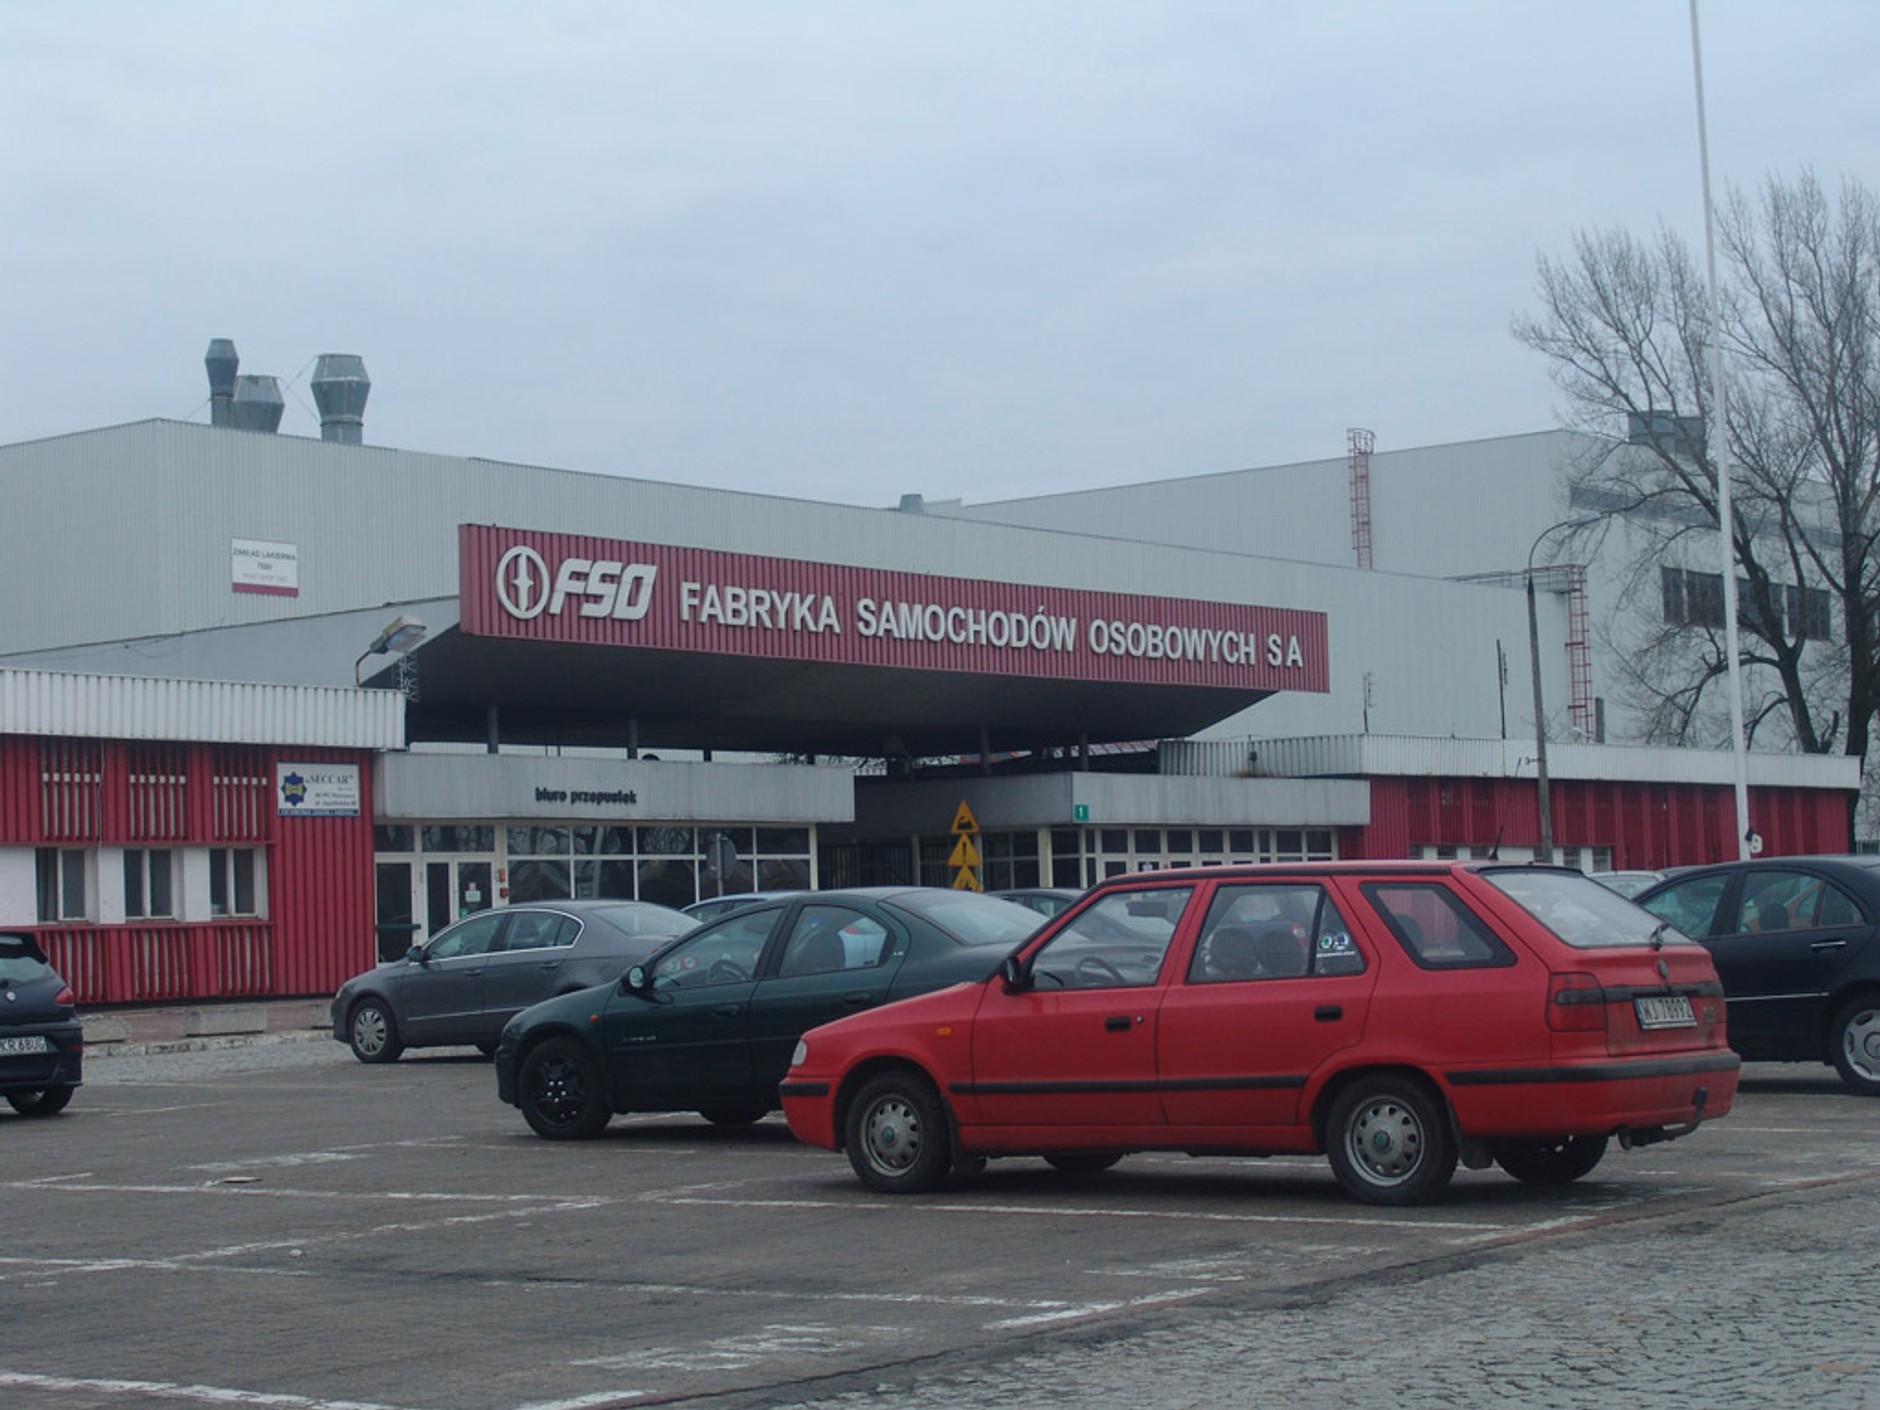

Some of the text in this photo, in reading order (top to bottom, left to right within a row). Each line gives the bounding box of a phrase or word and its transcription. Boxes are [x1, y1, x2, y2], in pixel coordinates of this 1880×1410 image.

[548, 557, 658, 620] FSO
[680, 581, 1304, 668] FABRYKA SAMOCHODÓW OSOBOWYCH SA
[535, 786, 567, 802] biuro
